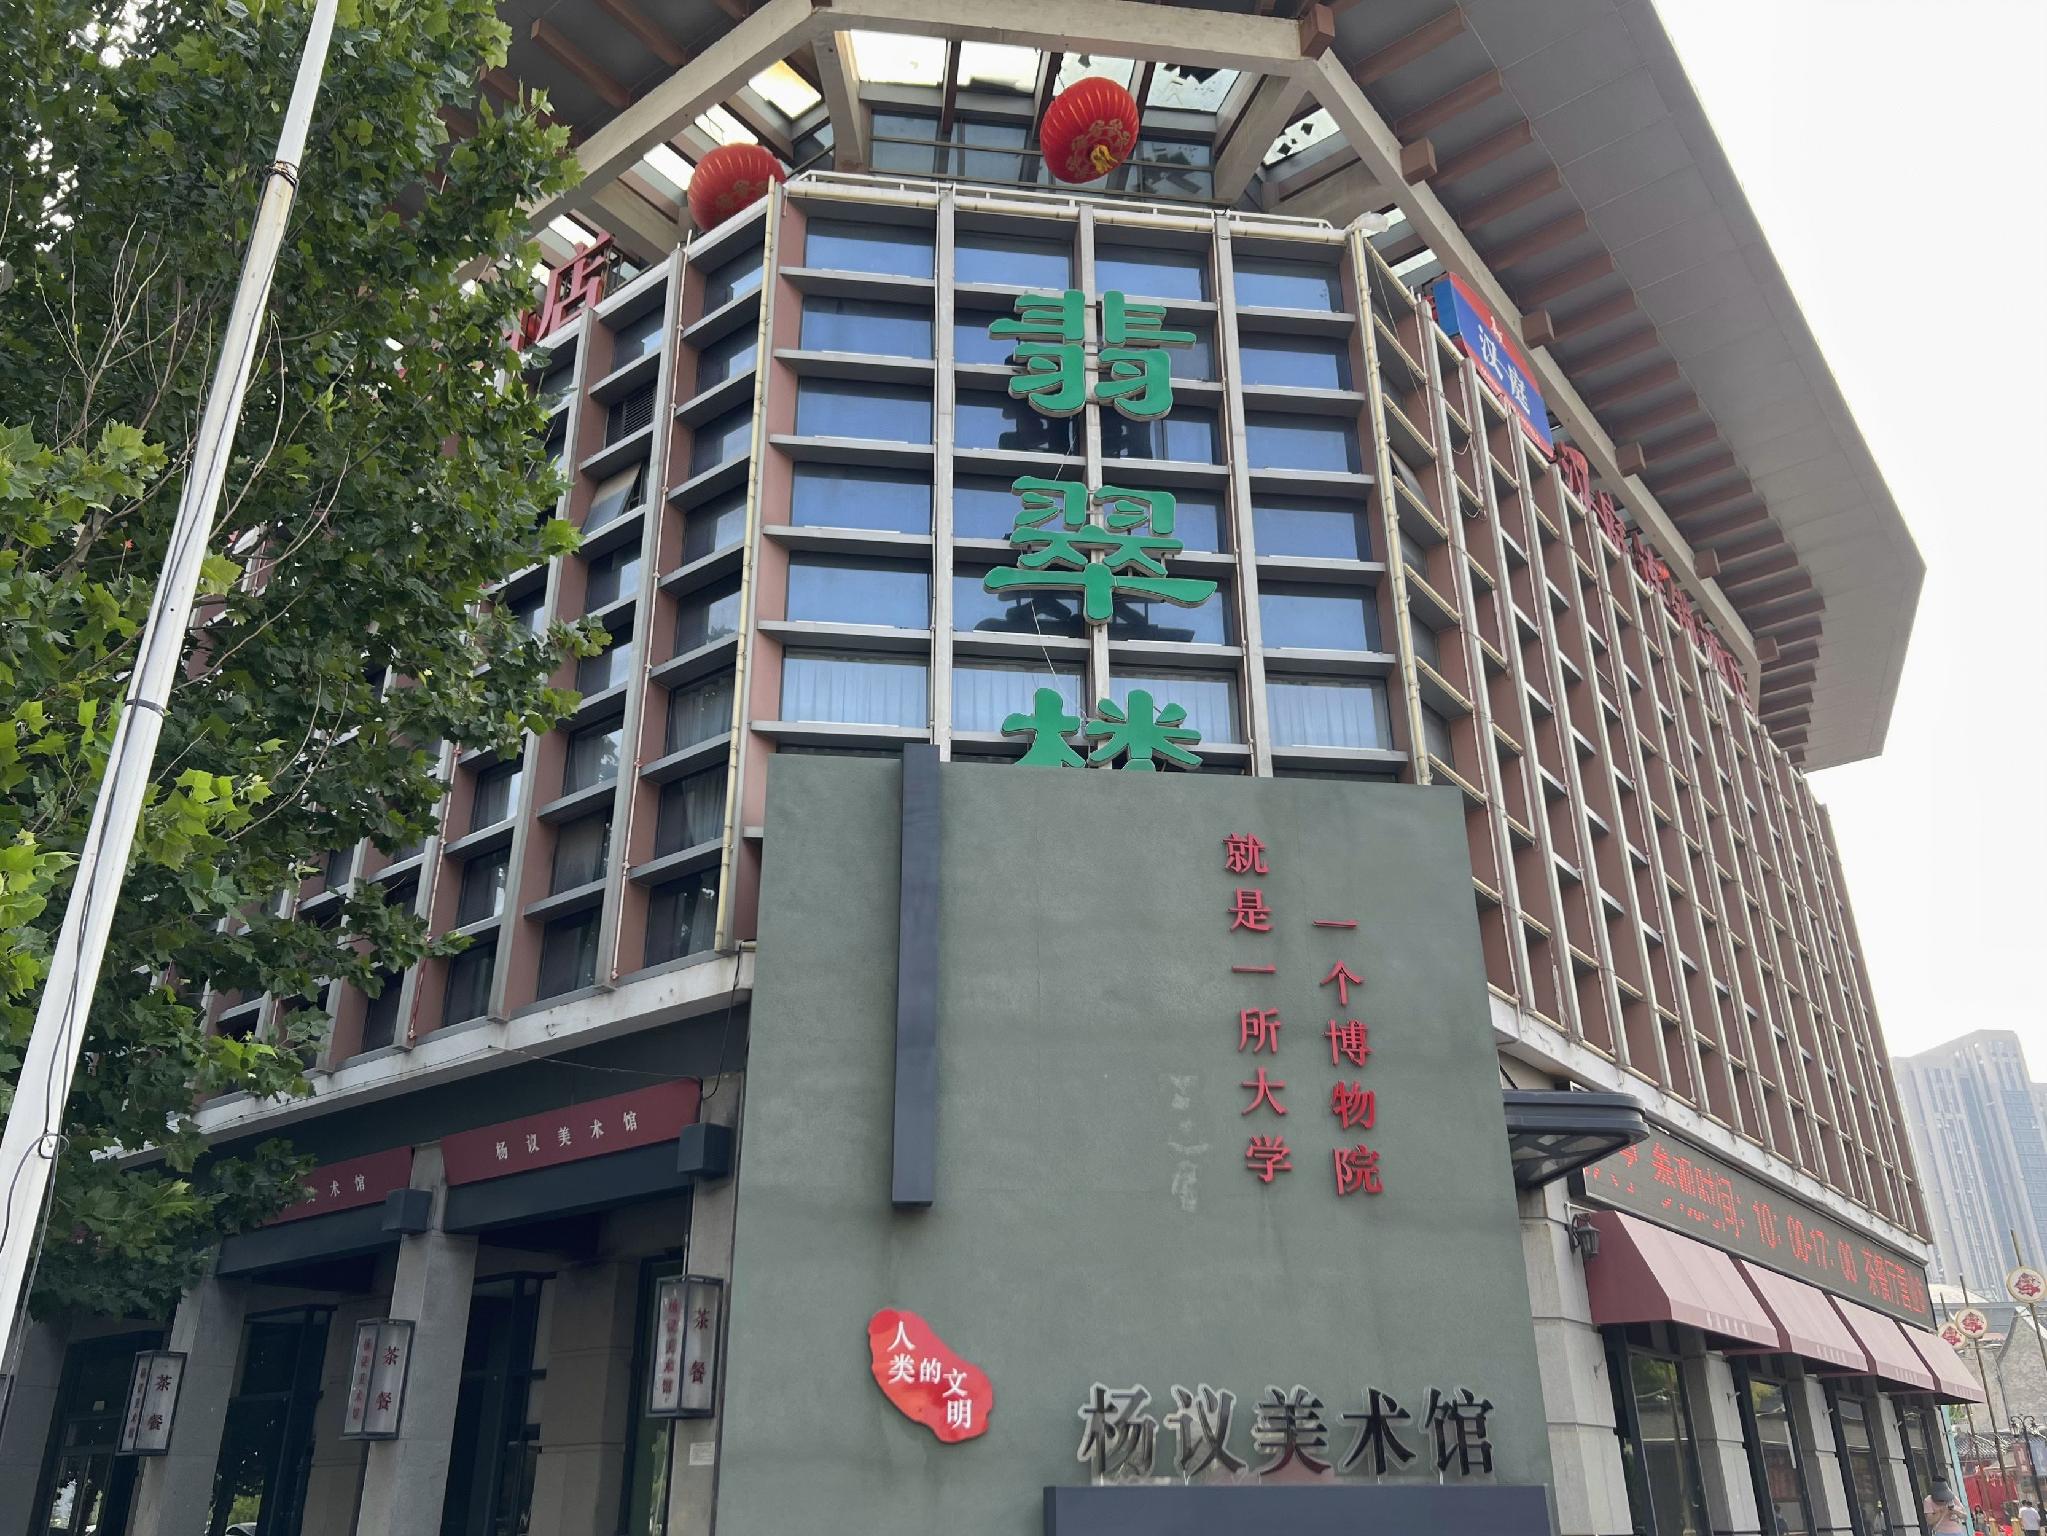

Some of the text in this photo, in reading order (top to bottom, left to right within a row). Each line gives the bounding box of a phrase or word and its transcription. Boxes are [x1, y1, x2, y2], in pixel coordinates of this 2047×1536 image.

[1478, 323, 1532, 417] 汉庭
[1221, 831, 1294, 1184] 就是一所大学
[1312, 919, 1383, 1197] 一个博物院
[495, 1109, 638, 1161] 杨议美术馆
[375, 1345, 401, 1411] 茶餐
[689, 1306, 710, 1385] 茶餐
[886, 1320, 973, 1430] 人类的文明
[146, 1373, 173, 1431] 茶餐
[1077, 1382, 1495, 1478] 杨议美术馆
